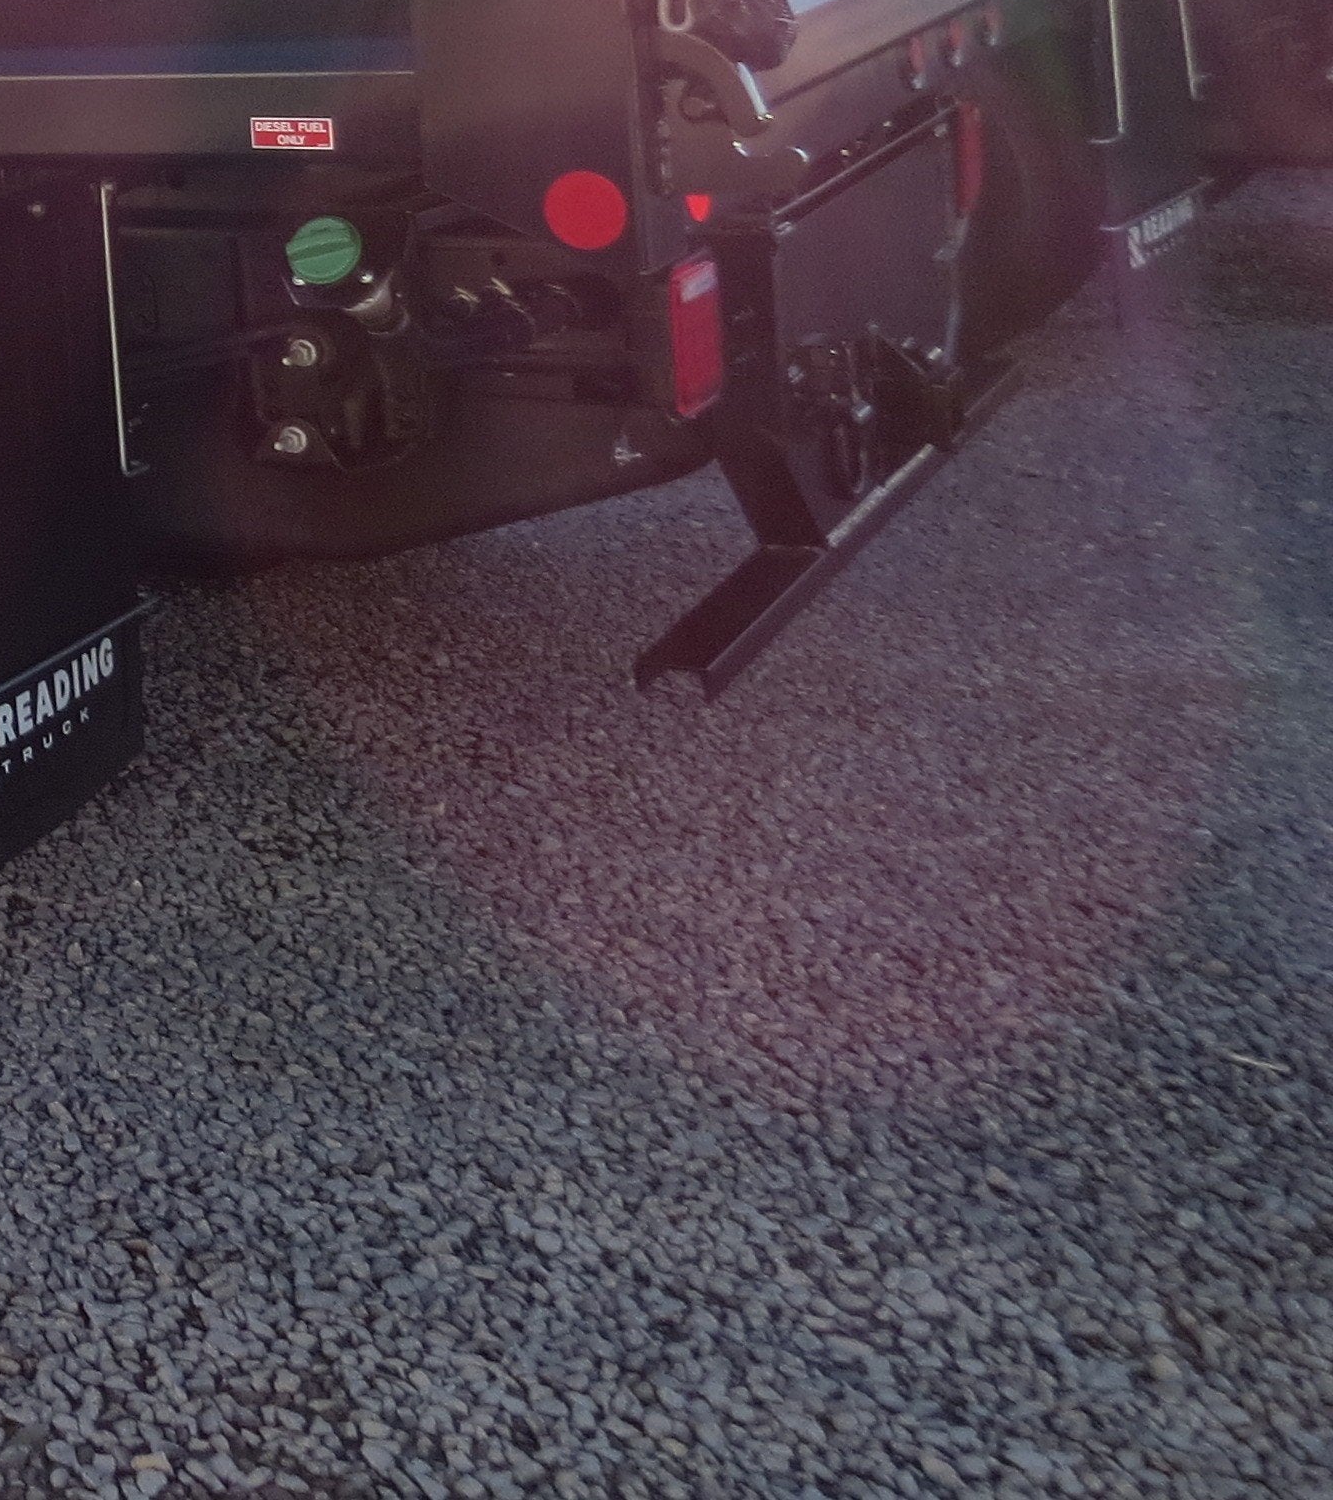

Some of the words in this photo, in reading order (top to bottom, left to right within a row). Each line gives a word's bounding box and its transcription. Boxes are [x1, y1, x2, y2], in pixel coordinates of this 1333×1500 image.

[255, 121, 295, 132] DIESEL
[298, 122, 327, 133] FUEL
[277, 134, 306, 146] ONLY
[1, 706, 90, 775] TRUCK
